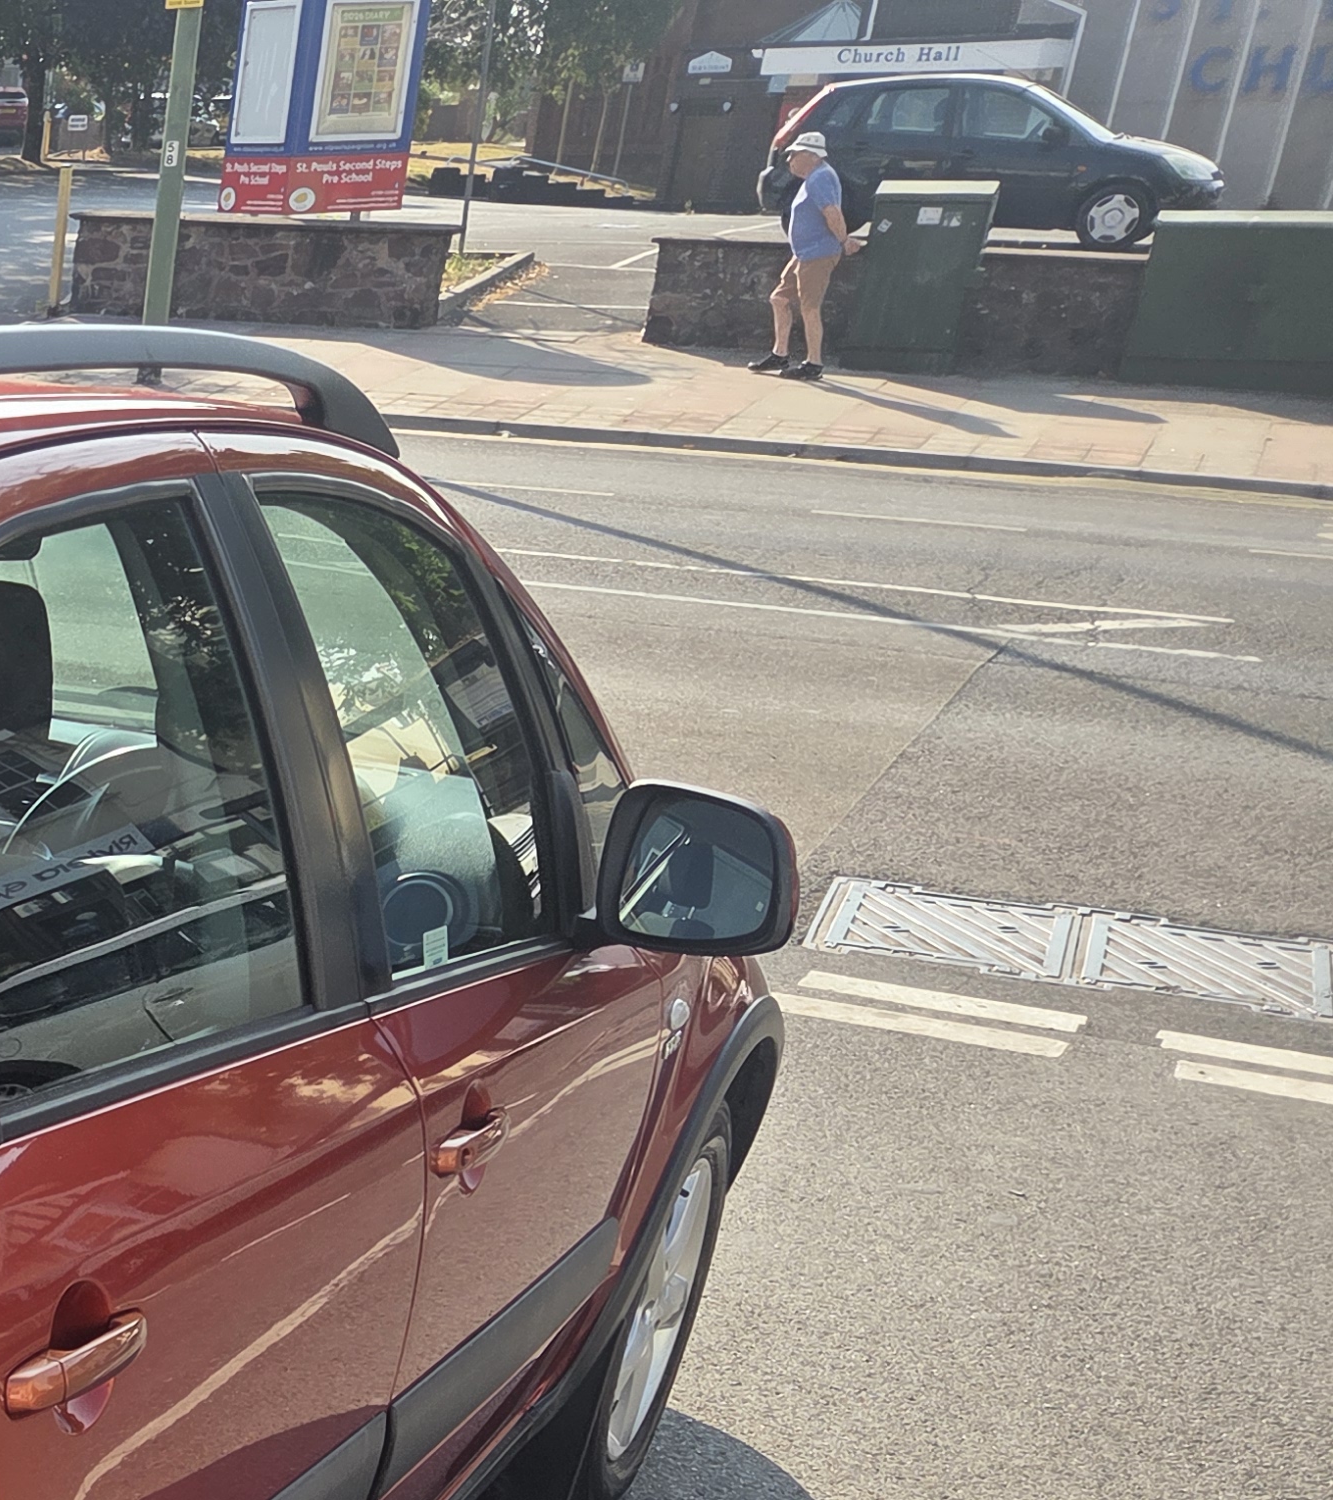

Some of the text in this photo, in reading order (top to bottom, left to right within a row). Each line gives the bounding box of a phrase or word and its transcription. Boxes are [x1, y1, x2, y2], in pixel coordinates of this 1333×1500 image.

[837, 45, 961, 64] Church Hall
[296, 158, 403, 173] St. Pauls Second Steps
[322, 171, 373, 184] Pre School
